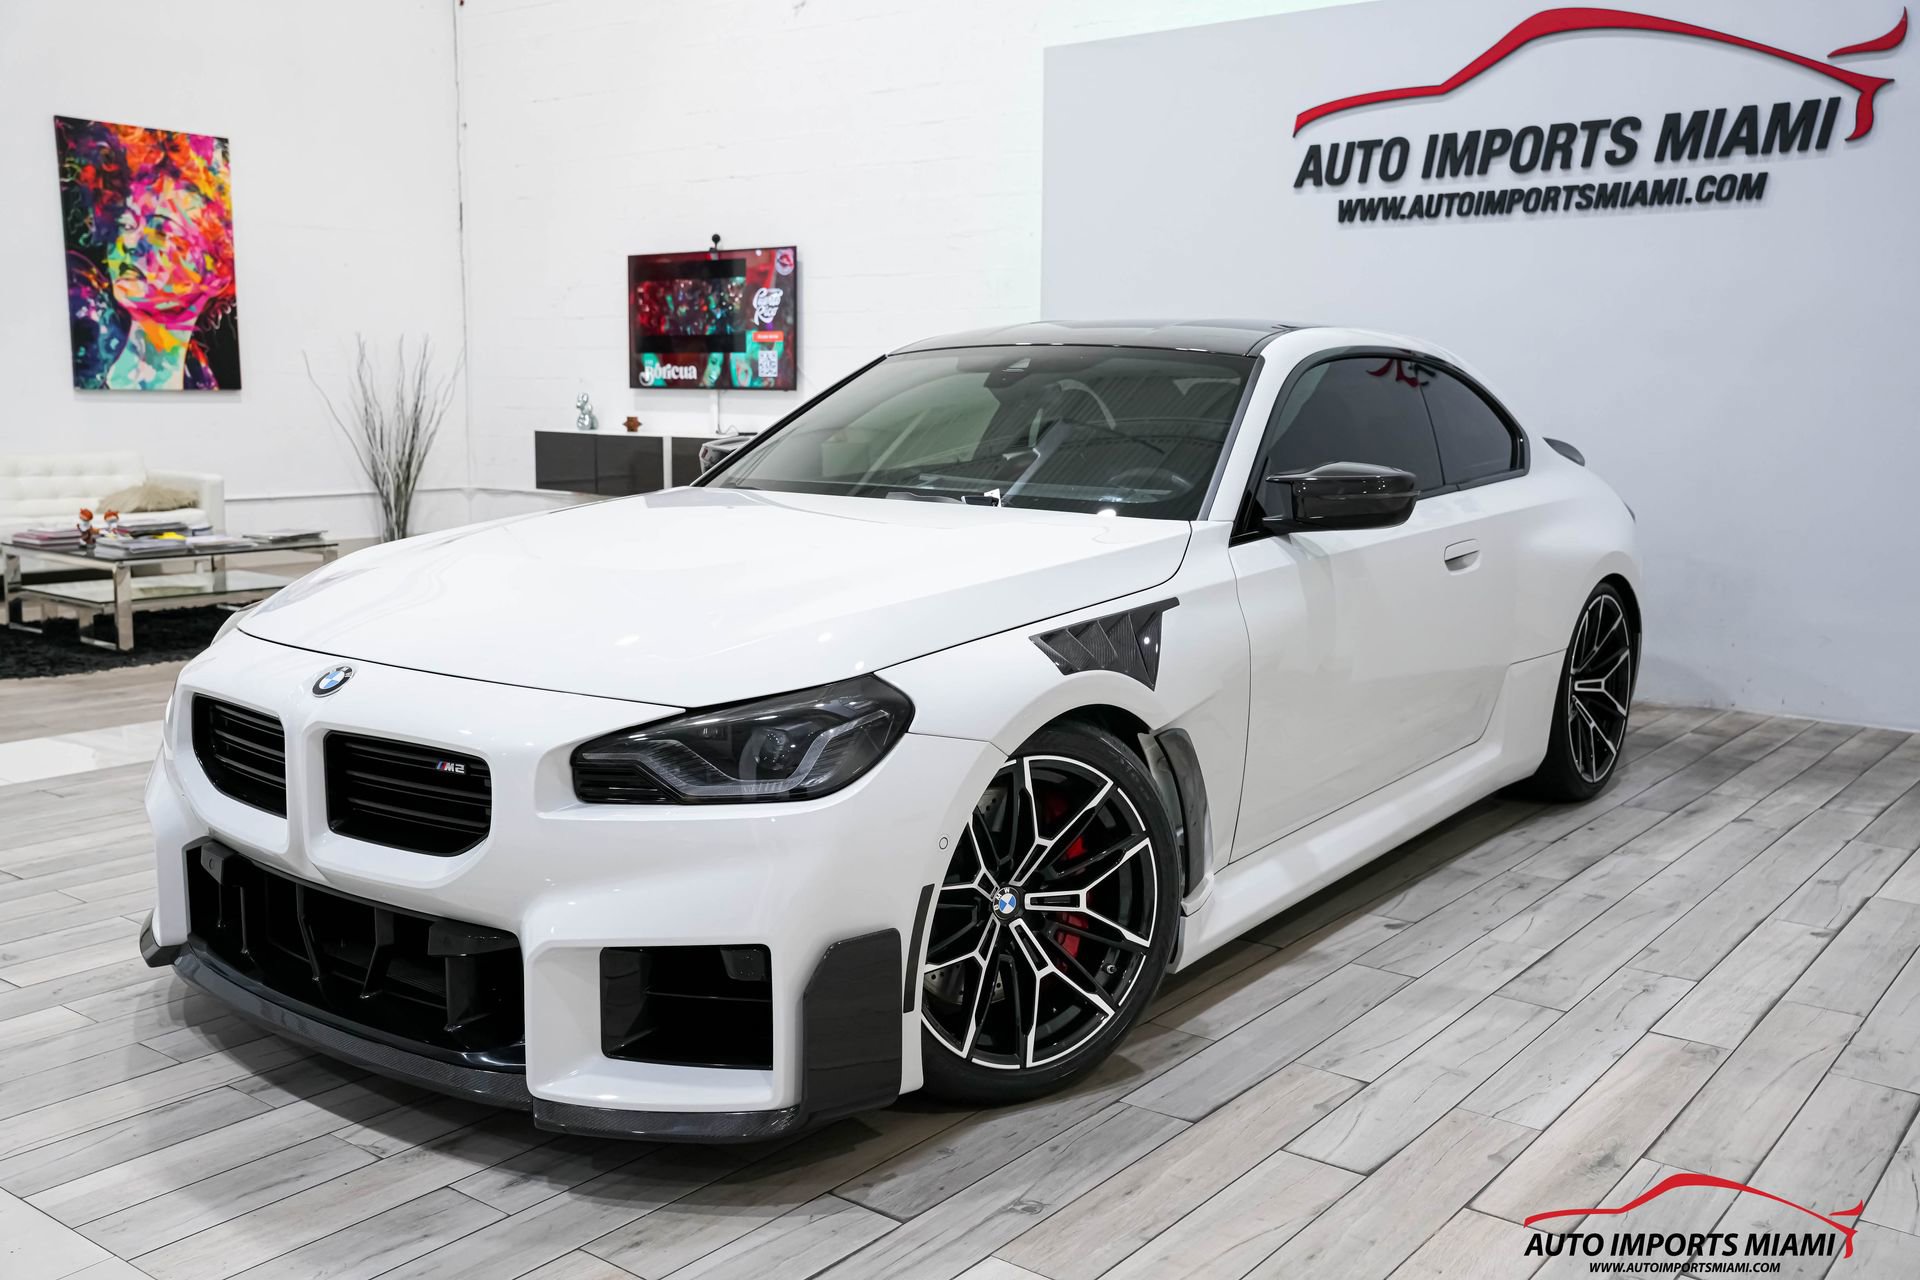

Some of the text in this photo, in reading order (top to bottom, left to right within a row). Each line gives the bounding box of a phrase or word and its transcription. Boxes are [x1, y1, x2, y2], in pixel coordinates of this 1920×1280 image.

[1293, 96, 1842, 188] AUTO IMPORTS MIAMI
[1337, 172, 1769, 223] WWW.AUTOIMPORTSMIAMI.COM
[443, 762, 465, 774] M2
